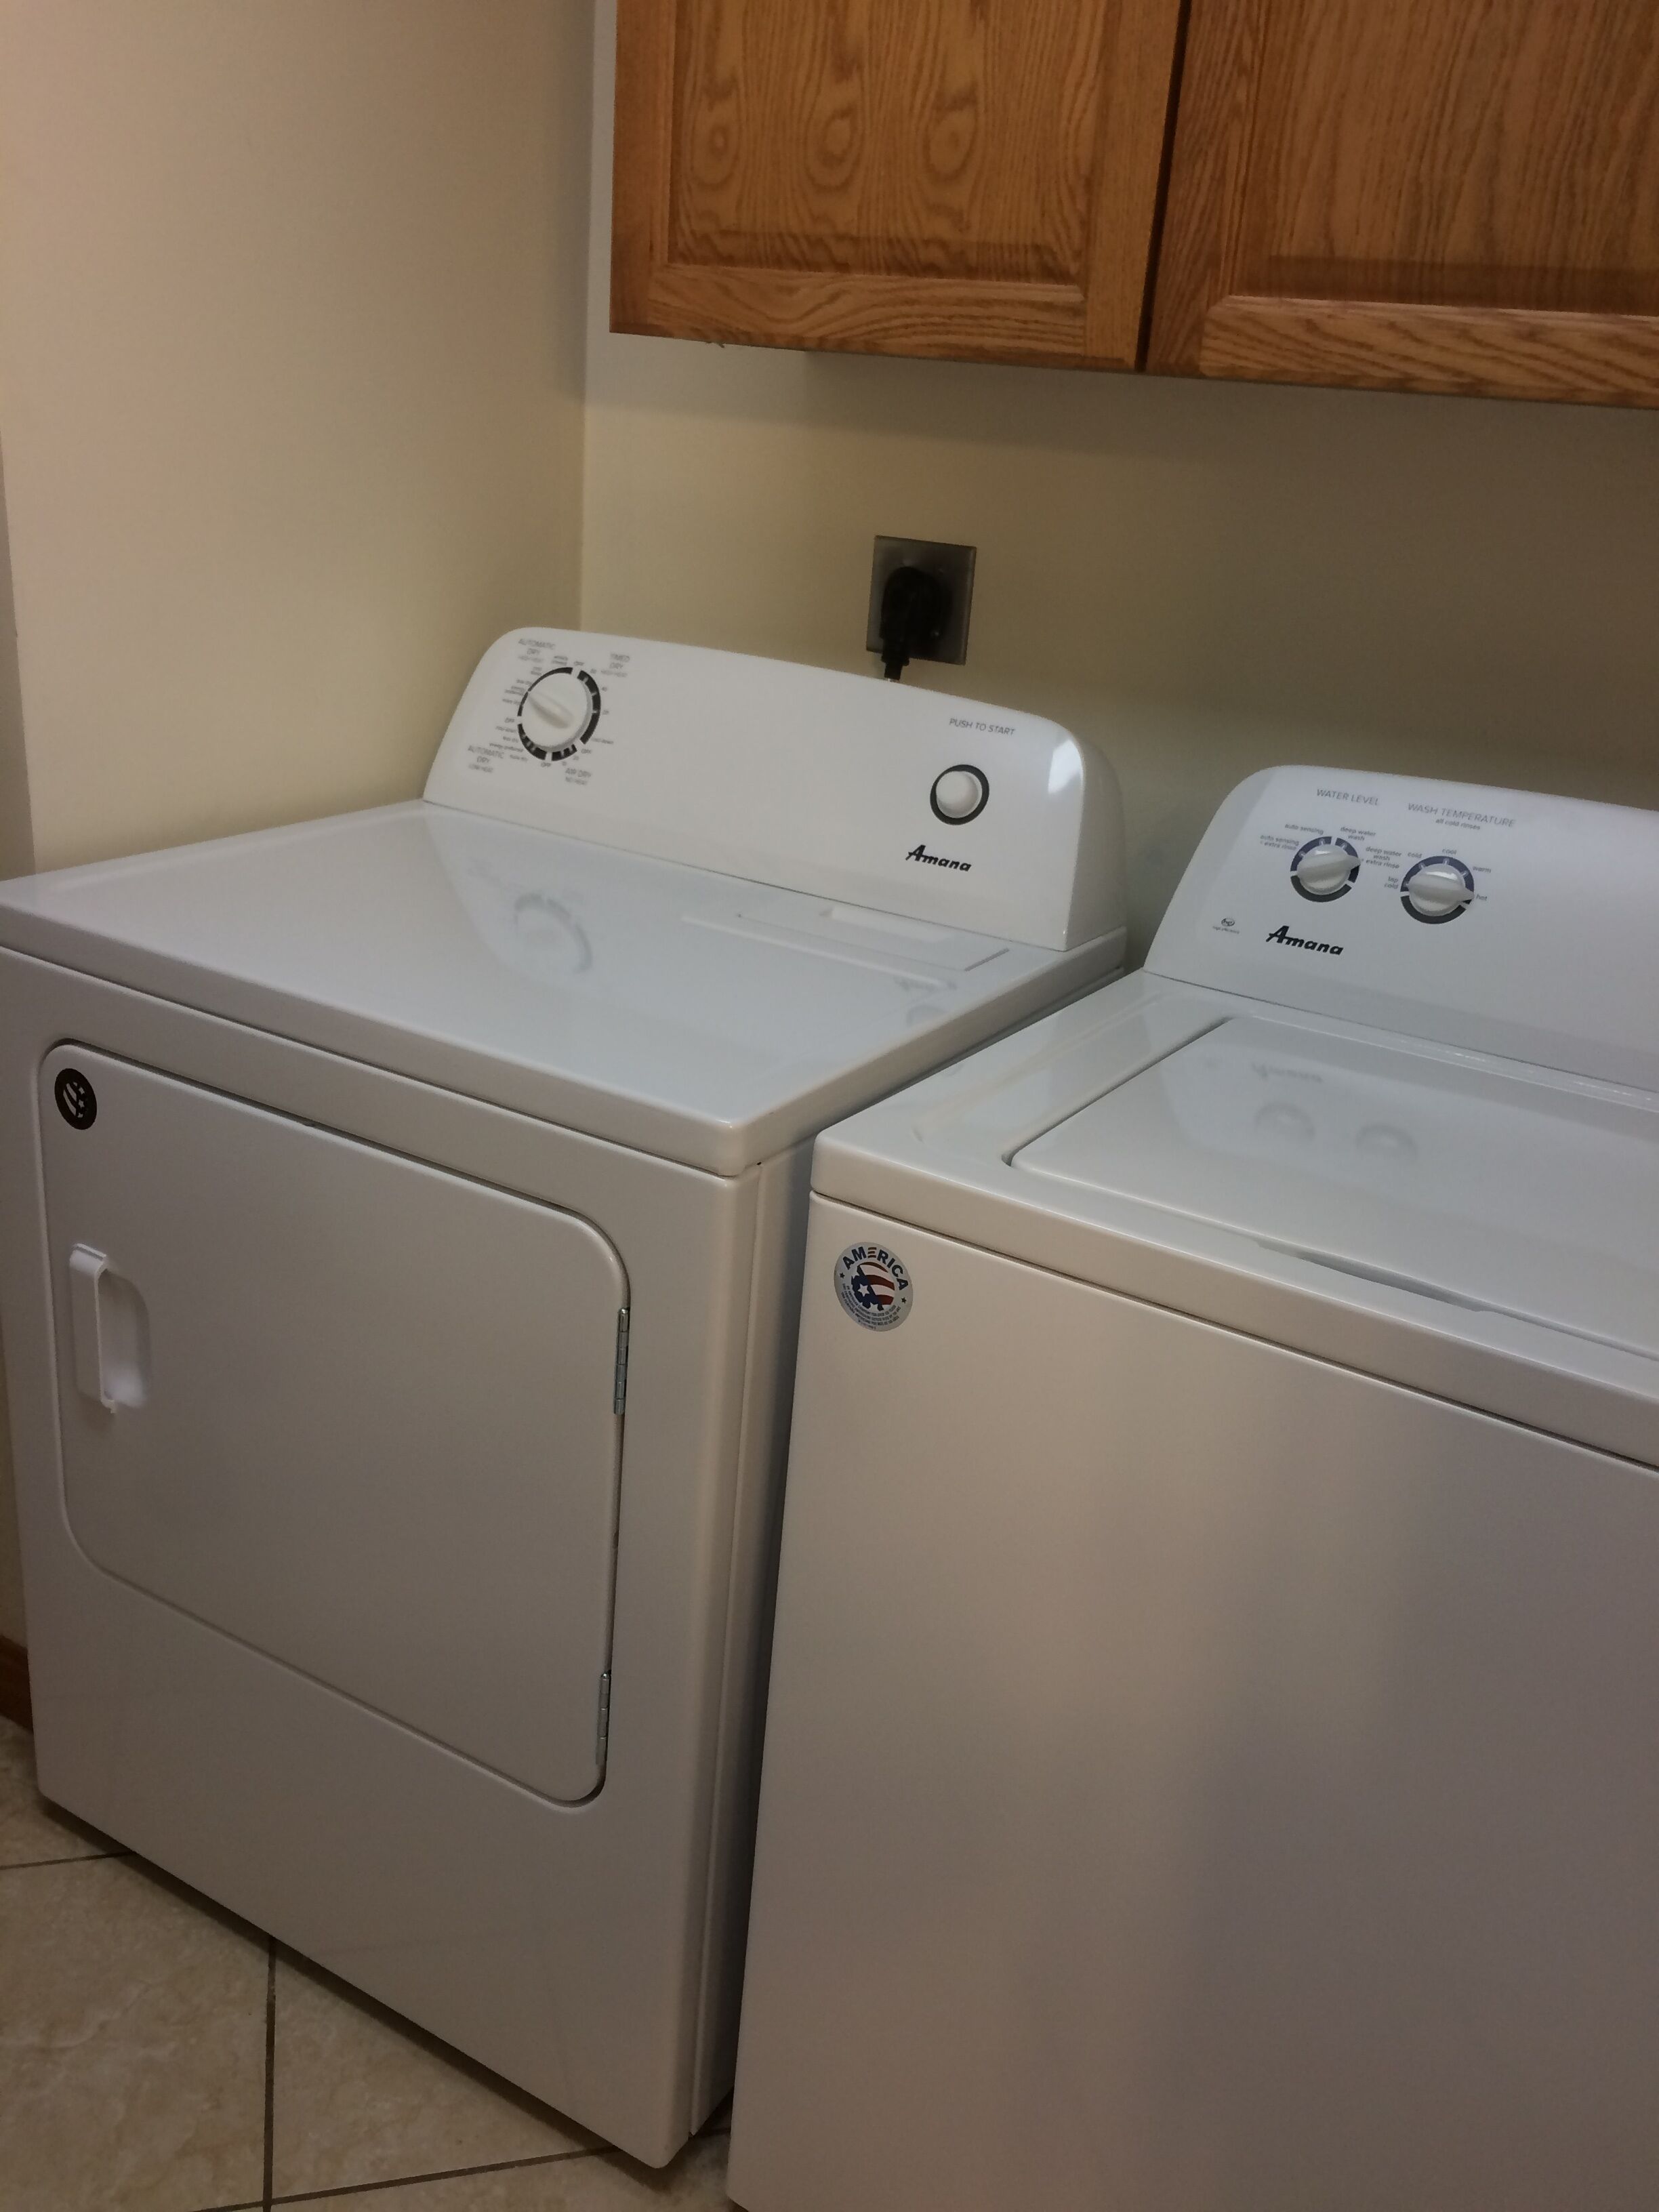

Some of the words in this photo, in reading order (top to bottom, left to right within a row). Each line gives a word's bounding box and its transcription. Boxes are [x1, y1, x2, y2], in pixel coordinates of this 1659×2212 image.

[949, 717, 972, 729] PUSH
[975, 721, 987, 732] TO
[988, 724, 1016, 735] START
[468, 745, 505, 759] AUTOMATIC
[1316, 789, 1349, 800] WATER
[1351, 794, 1378, 806] LEVEL
[1408, 802, 1438, 816] WASH
[1440, 807, 1517, 827] TEMPERATURE
[1299, 825, 1324, 835] sensing
[1340, 826, 1357, 835] deep
[1357, 828, 1376, 836] water
[1275, 836, 1299, 846] sensing
[905, 844, 972, 872] Amana
[1366, 846, 1383, 855] deep
[1383, 848, 1402, 857] water
[1366, 858, 1383, 866] extra
[1383, 861, 1400, 869] rinse
[1387, 876, 1399, 884] tap
[1265, 925, 1344, 956] Amana
[842, 1246, 909, 1291] AMERICA
